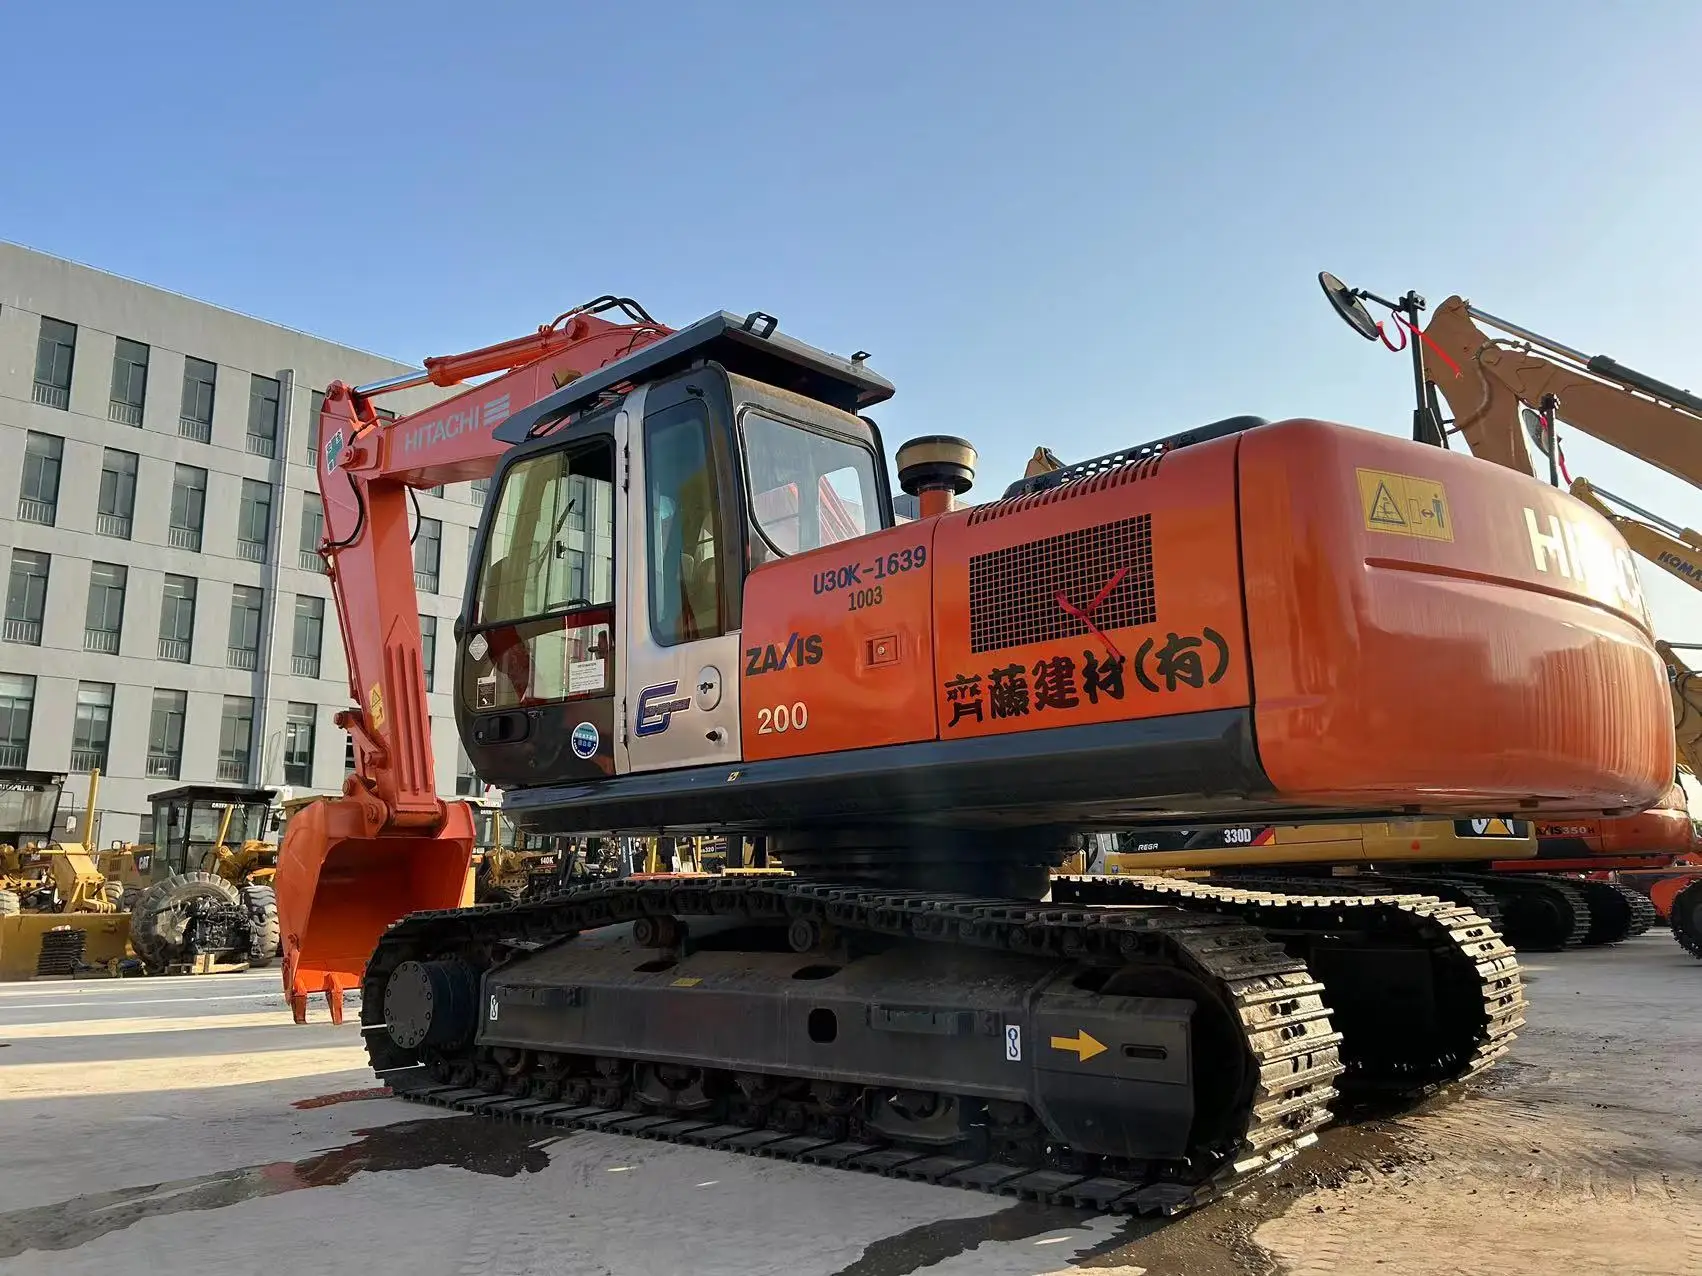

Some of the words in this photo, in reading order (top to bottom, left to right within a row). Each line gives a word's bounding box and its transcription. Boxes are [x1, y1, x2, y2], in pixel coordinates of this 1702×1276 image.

[405, 406, 479, 454] HITACHI
[813, 545, 927, 595] U30K-1639
[848, 585, 883, 611] 1003
[745, 632, 823, 676] ZAXIS
[757, 701, 808, 735] 200
[1224, 828, 1251, 844] 330D
[138, 855, 150, 869] CAT
